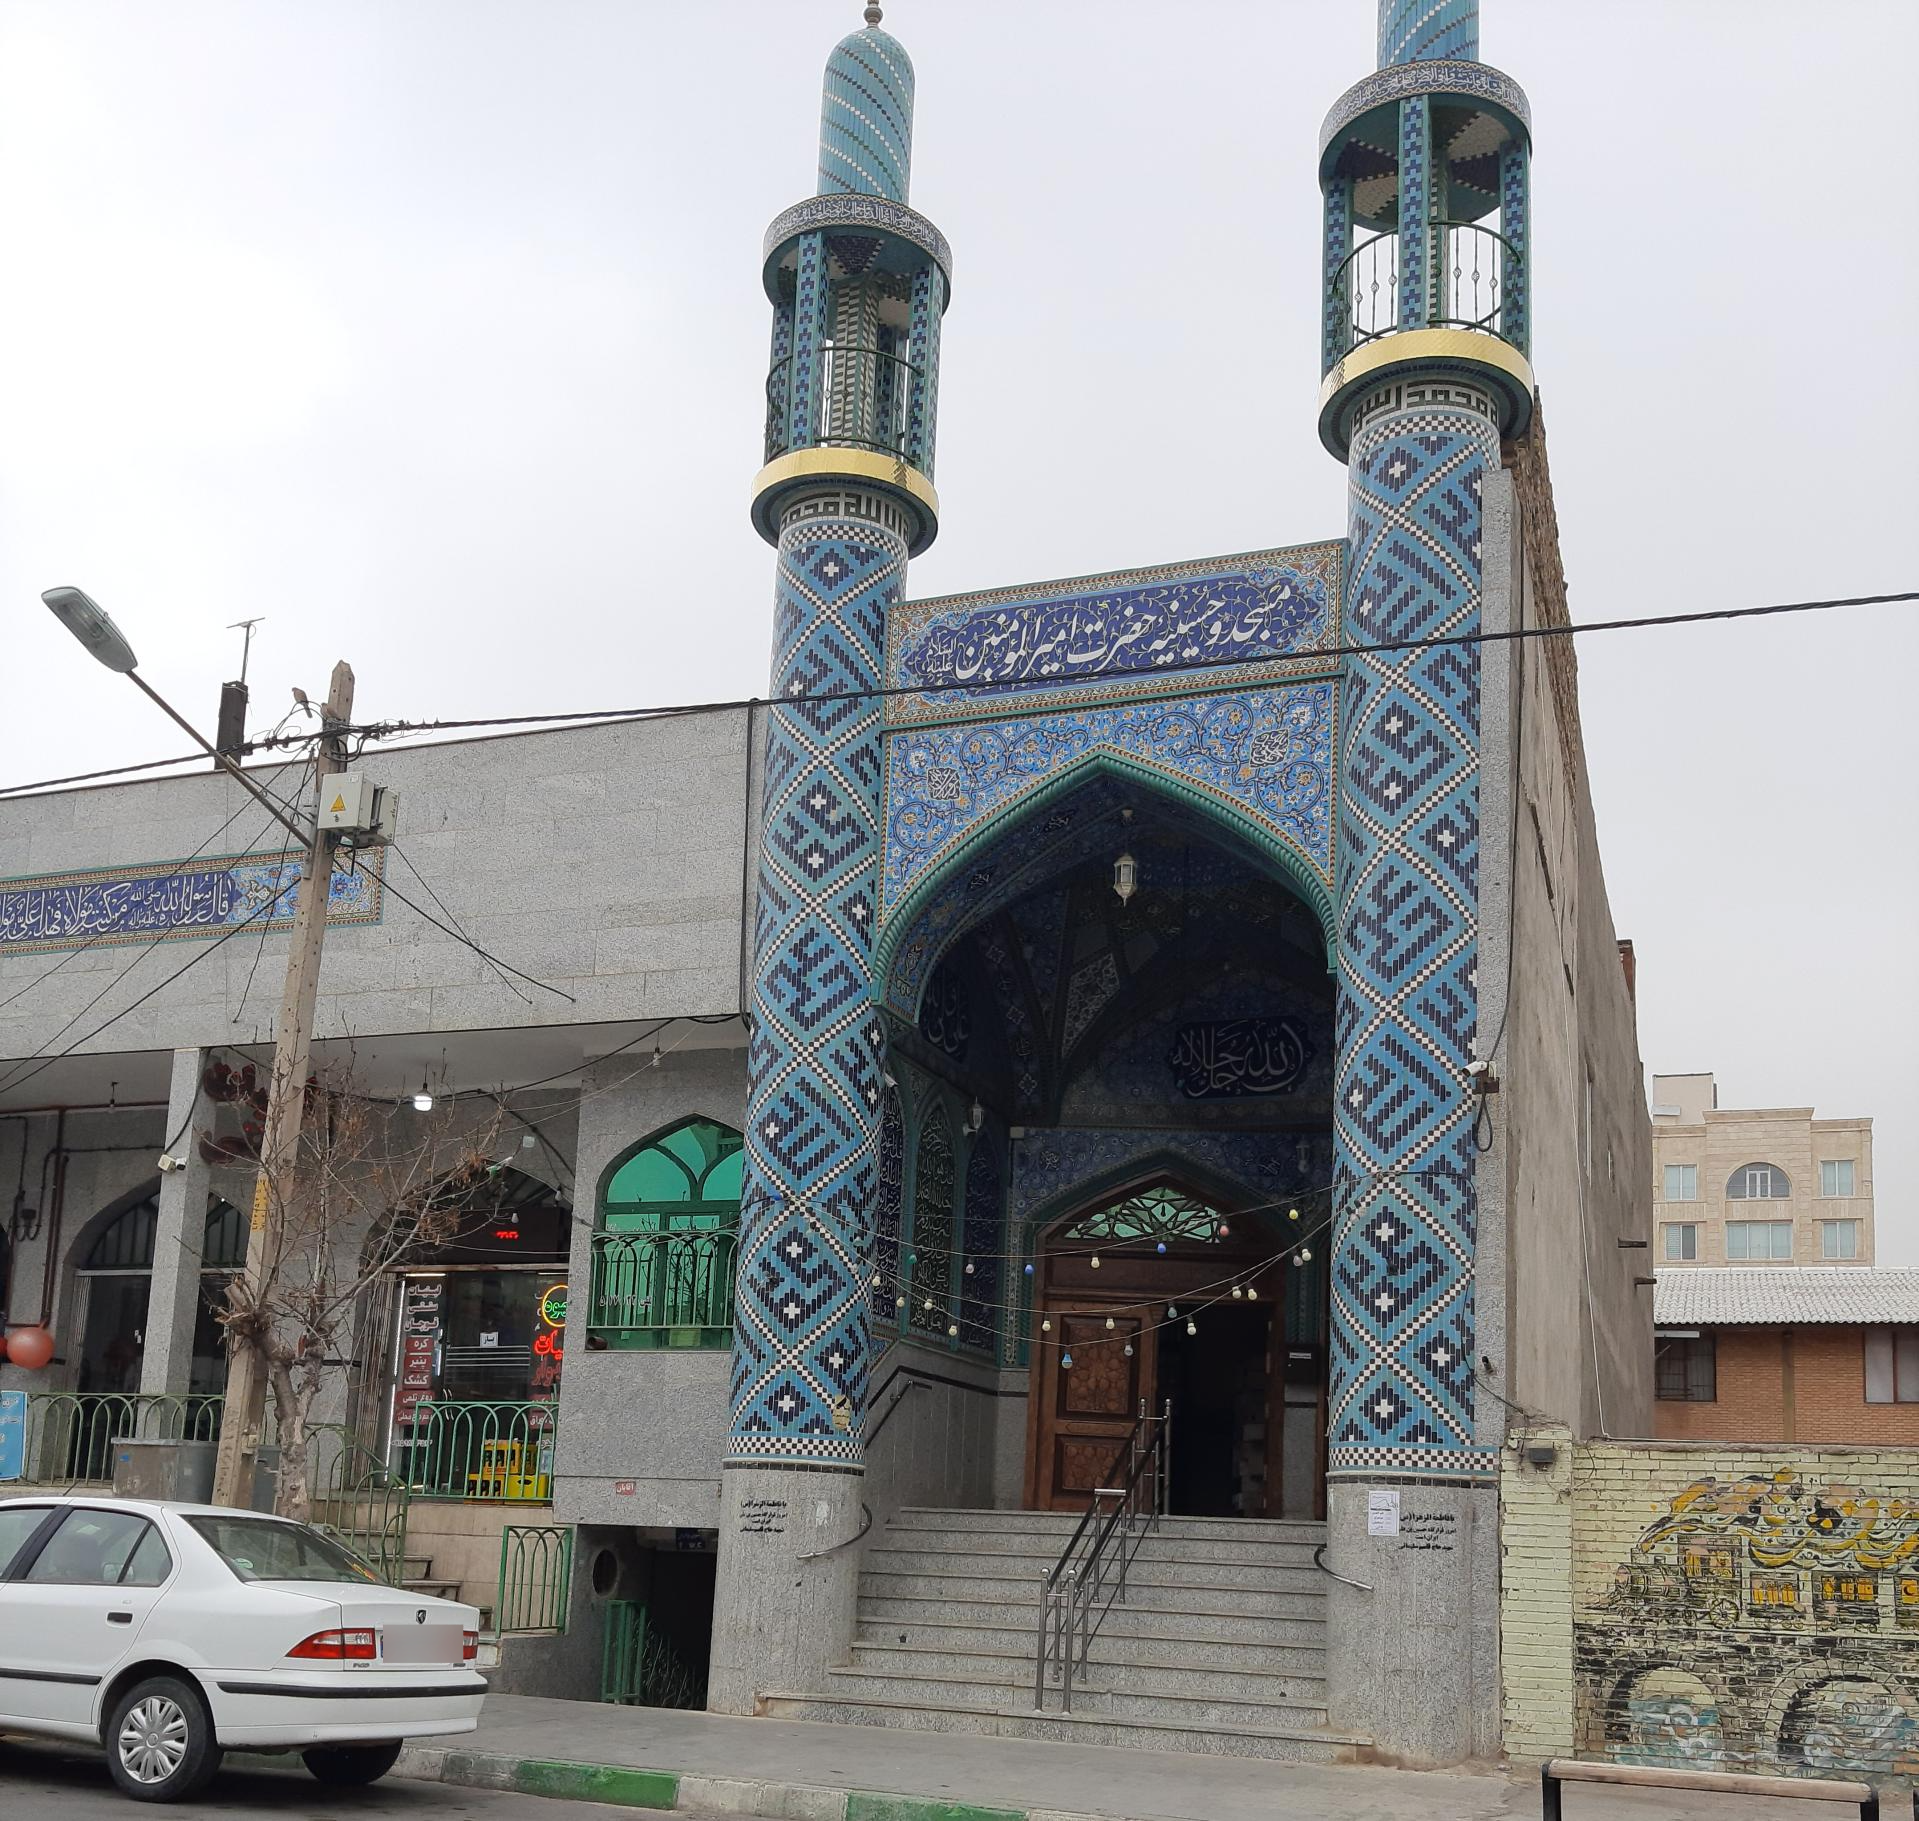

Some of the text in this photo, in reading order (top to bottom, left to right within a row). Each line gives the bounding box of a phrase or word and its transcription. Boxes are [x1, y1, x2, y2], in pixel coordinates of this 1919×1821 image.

[1219, 585, 1291, 643] مسجد
[1067, 604, 1157, 672] حضرت
[1149, 598, 1226, 665] حسینیه
[1205, 620, 1223, 646] و
[1019, 612, 1079, 678] امیر
[197, 874, 230, 923] قال
[408, 1284, 442, 1298] لبنیات
[404, 1317, 439, 1332] قوچان
[414, 1339, 429, 1350] کره
[409, 1356, 427, 1370] پنیر
[404, 1374, 429, 1385] کشک
